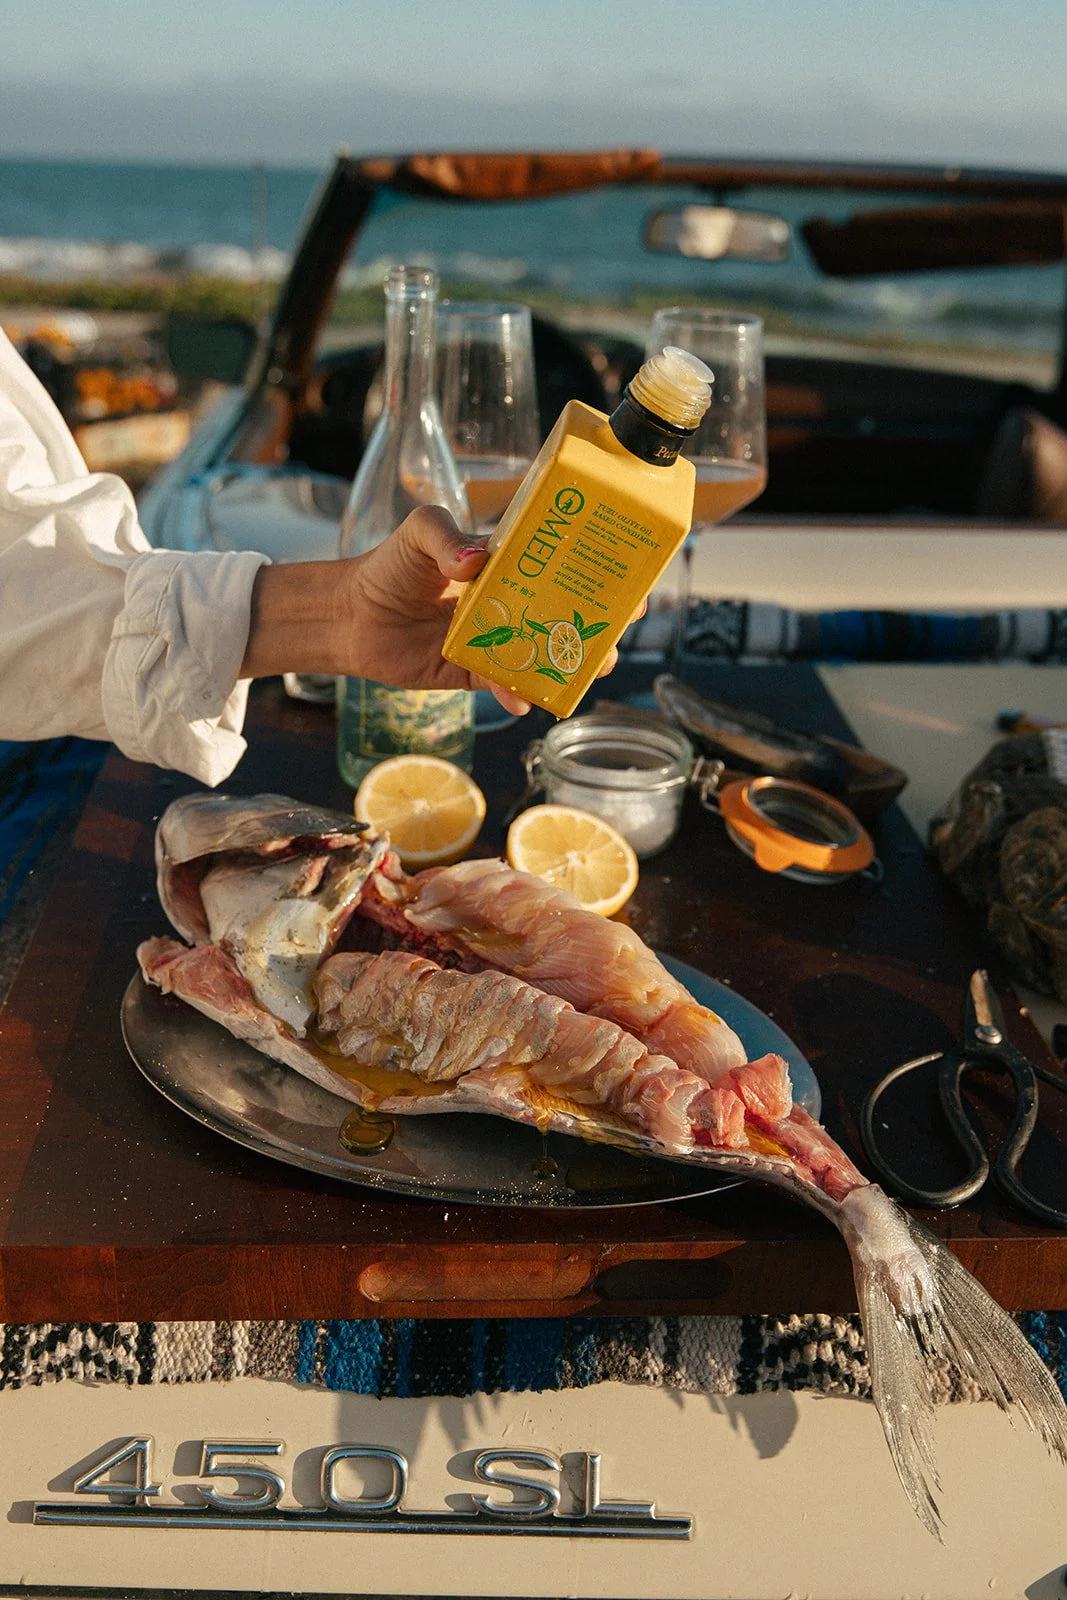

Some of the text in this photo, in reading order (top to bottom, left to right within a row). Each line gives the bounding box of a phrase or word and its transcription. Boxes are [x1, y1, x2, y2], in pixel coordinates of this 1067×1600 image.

[517, 487, 585, 578] OMED
[593, 510, 660, 549] BASED CONDIMENT
[597, 503, 654, 536] YUZU OLIVE OIL
[570, 547, 627, 580] Arbequina olive oil
[575, 538, 628, 571] Yuzu infused with
[555, 570, 596, 594] aceite de oliva
[560, 562, 605, 589] Condimento de
[551, 577, 609, 611] Arbequina con yuzu
[74, 1436, 656, 1518] 450 SL
